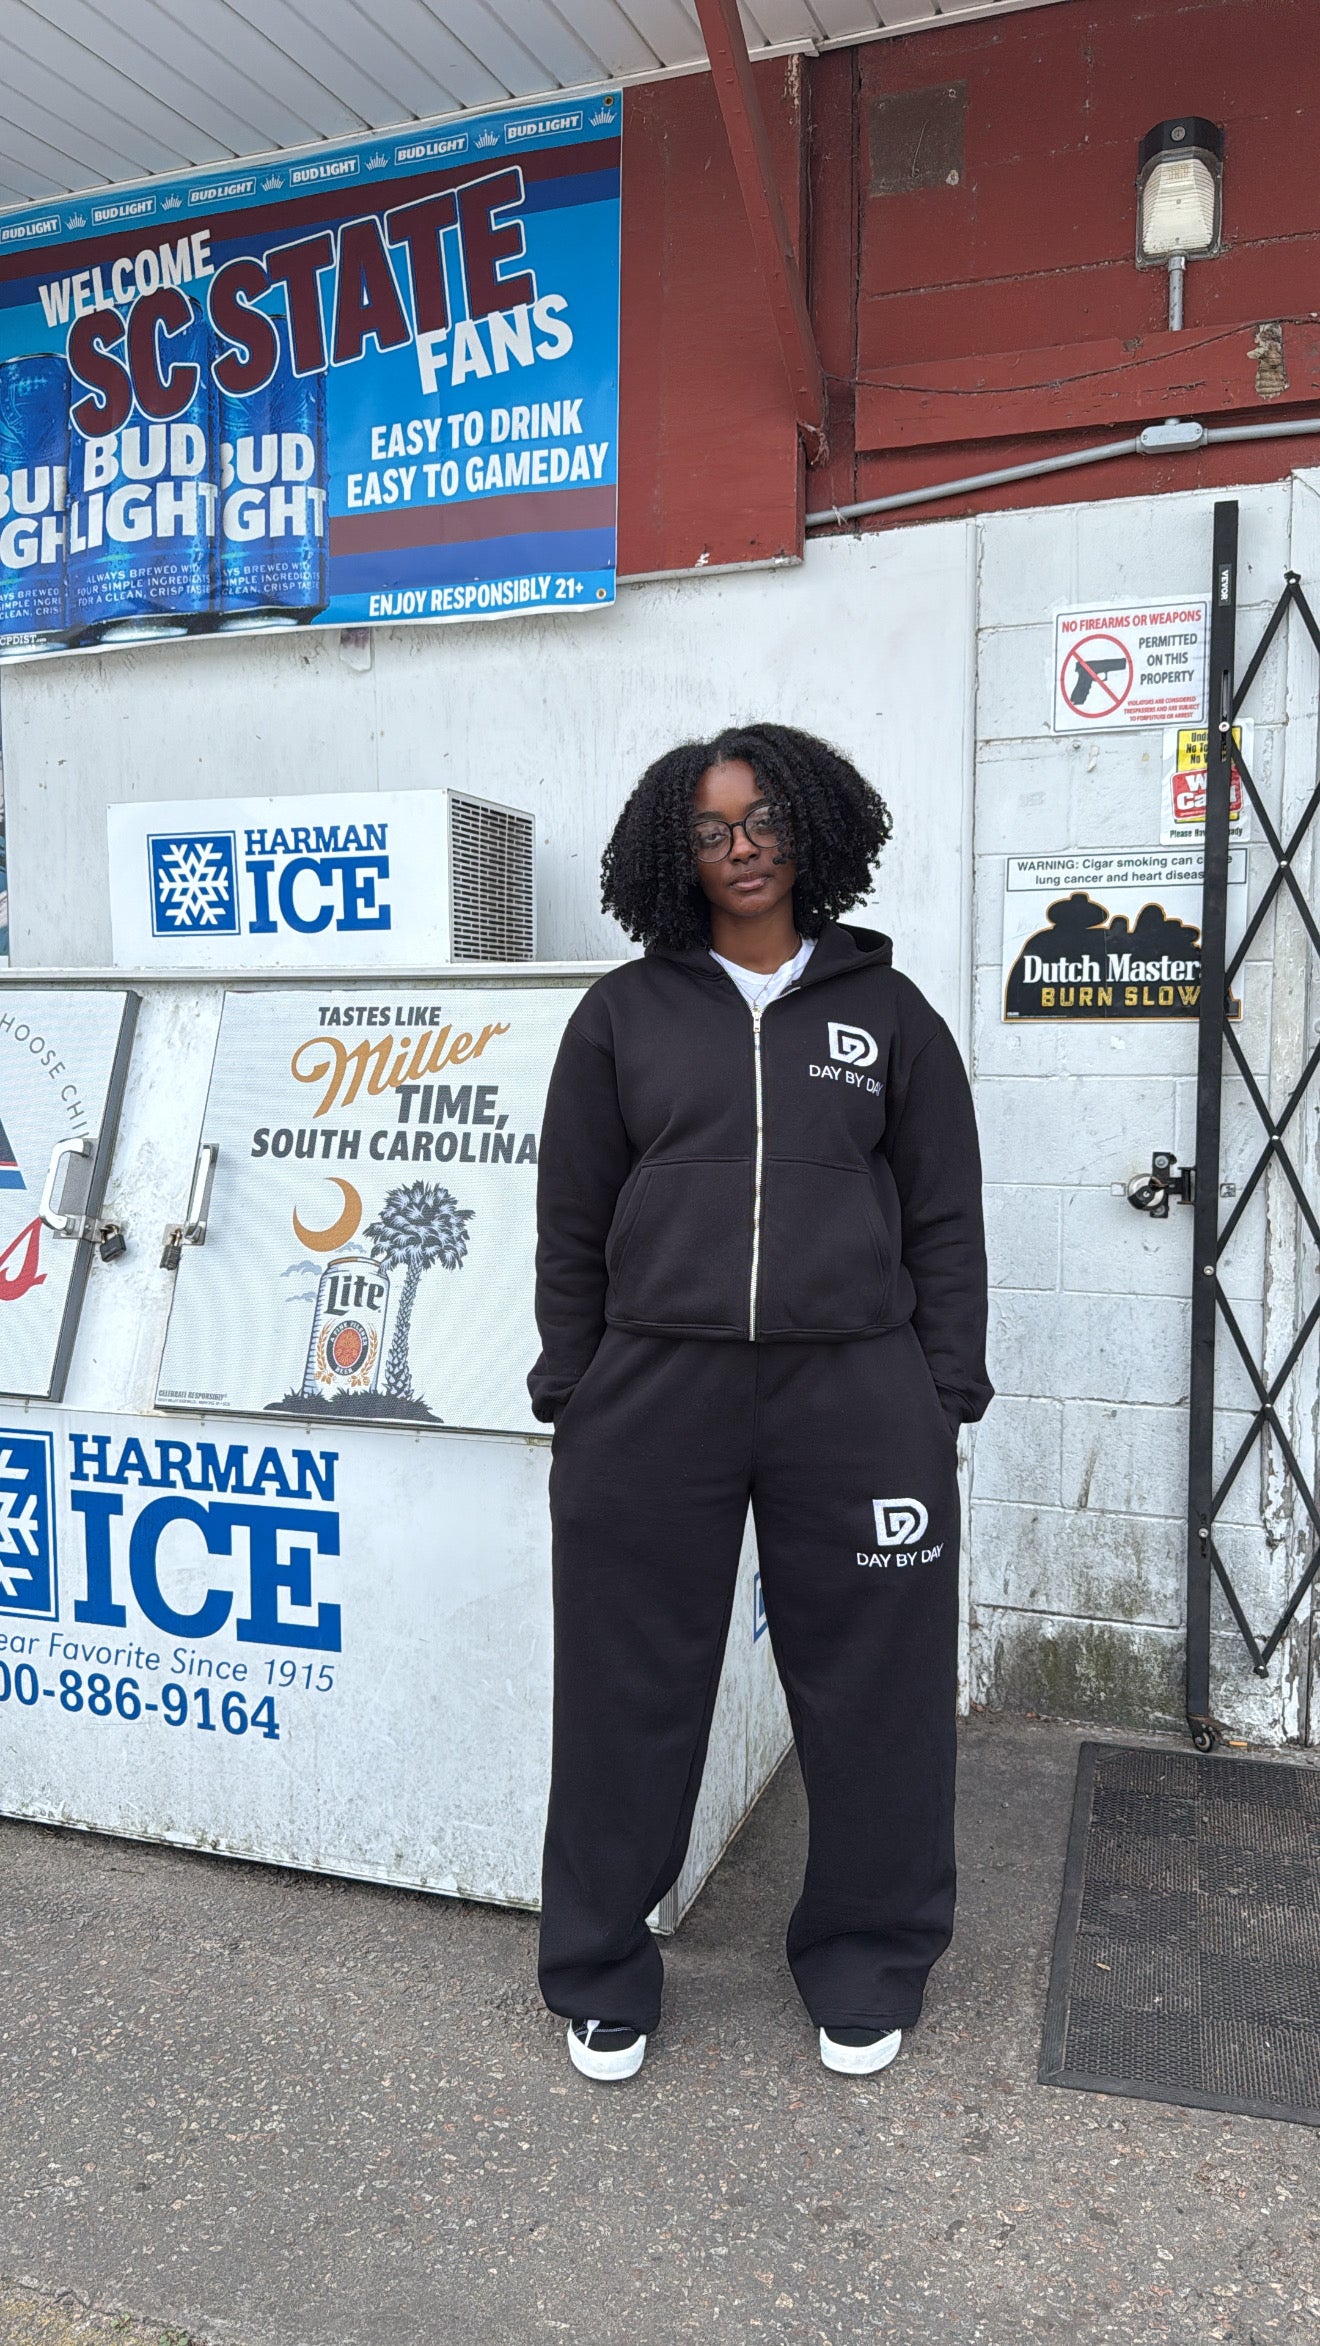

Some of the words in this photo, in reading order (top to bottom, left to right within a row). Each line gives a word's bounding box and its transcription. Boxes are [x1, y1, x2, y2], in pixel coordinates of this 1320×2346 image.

[508, 125, 537, 140] BUD
[538, 116, 579, 134] LIGHT
[398, 146, 424, 162] BUD
[424, 138, 465, 156] LIGHT
[292, 167, 319, 182] BUD
[319, 160, 356, 178] LIGHT
[191, 189, 216, 202] BUD
[216, 182, 252, 198] LIGHT
[94, 208, 118, 222] BUD
[118, 200, 153, 218] LIGHT
[1, 227, 26, 242] BUD
[26, 220, 58, 236] LIGHT
[38, 229, 214, 328] WELCOME
[66, 284, 200, 440] SC
[207, 166, 537, 397] STATE
[415, 294, 574, 395] FANS
[371, 418, 442, 460] EASY
[448, 411, 484, 449] TO
[491, 398, 583, 442] DRINK
[84, 423, 206, 492] BUD
[347, 466, 417, 508] EASY
[423, 460, 459, 498] TO
[465, 442, 609, 492] GAMEDAY
[70, 482, 218, 554] LIGHT
[224, 486, 326, 542] GHT
[0, 518, 67, 569] GH
[87, 570, 126, 584] ALWAYS
[130, 565, 177, 578] BREWED
[244, 562, 288, 574] BREWED
[18, 588, 60, 599] BREWED
[96, 595, 102, 604] A
[150, 586, 184, 598] CRISP
[102, 579, 144, 592] SIMPLE
[264, 582, 295, 592] CRISP
[369, 590, 427, 616] ENJOY
[431, 576, 551, 611] RESPONSIBLY
[555, 578, 584, 600] 21+
[1220, 570, 1228, 600] VEVOR
[1062, 620, 1078, 633] NO
[1080, 614, 1130, 631] FIREARMS
[1132, 614, 1148, 627] OR
[1150, 609, 1202, 625] WEAPONS
[1138, 633, 1198, 649] PERMITTED
[1146, 654, 1163, 666] ON
[1164, 651, 1188, 665] THIS
[1140, 670, 1194, 685] PROPERTY
[244, 823, 389, 856] HARMAN
[1170, 829, 1192, 838] Please
[1018, 860, 1079, 872] WARNING:
[1082, 857, 1114, 872] Cigar
[1116, 856, 1167, 870] smoking
[1170, 857, 1193, 866] can
[1036, 874, 1060, 886] lung
[1064, 874, 1104, 884] cancer
[1106, 872, 1128, 882] and
[1132, 870, 1163, 882] heart
[1166, 870, 1205, 880] diseas
[245, 855, 391, 934] ICE
[1022, 954, 1100, 984] Dutch
[1106, 953, 1202, 982] Master
[1041, 986, 1112, 1007] BURN
[1124, 986, 1200, 1006] SLOW
[318, 1006, 391, 1026] TASTES
[394, 1006, 442, 1026] LIKE
[291, 1022, 511, 1119] Miller
[809, 1064, 841, 1080] DAY
[846, 1070, 864, 1088] BY
[866, 1078, 884, 1096] DAY
[394, 1084, 510, 1132] TIME,
[251, 1128, 362, 1160] SOUTH
[369, 1130, 538, 1164] CAROLINA
[324, 1274, 385, 1316] Lite
[69, 1433, 339, 1502] HARMAN
[856, 1552, 891, 1568] DAY
[896, 1552, 918, 1568] BY
[922, 1542, 944, 1564] DAY
[70, 1489, 342, 1652] ICE
[49, 1632, 161, 1671] Favorite
[170, 1648, 248, 1682] Since
[264, 1658, 335, 1692] 1915
